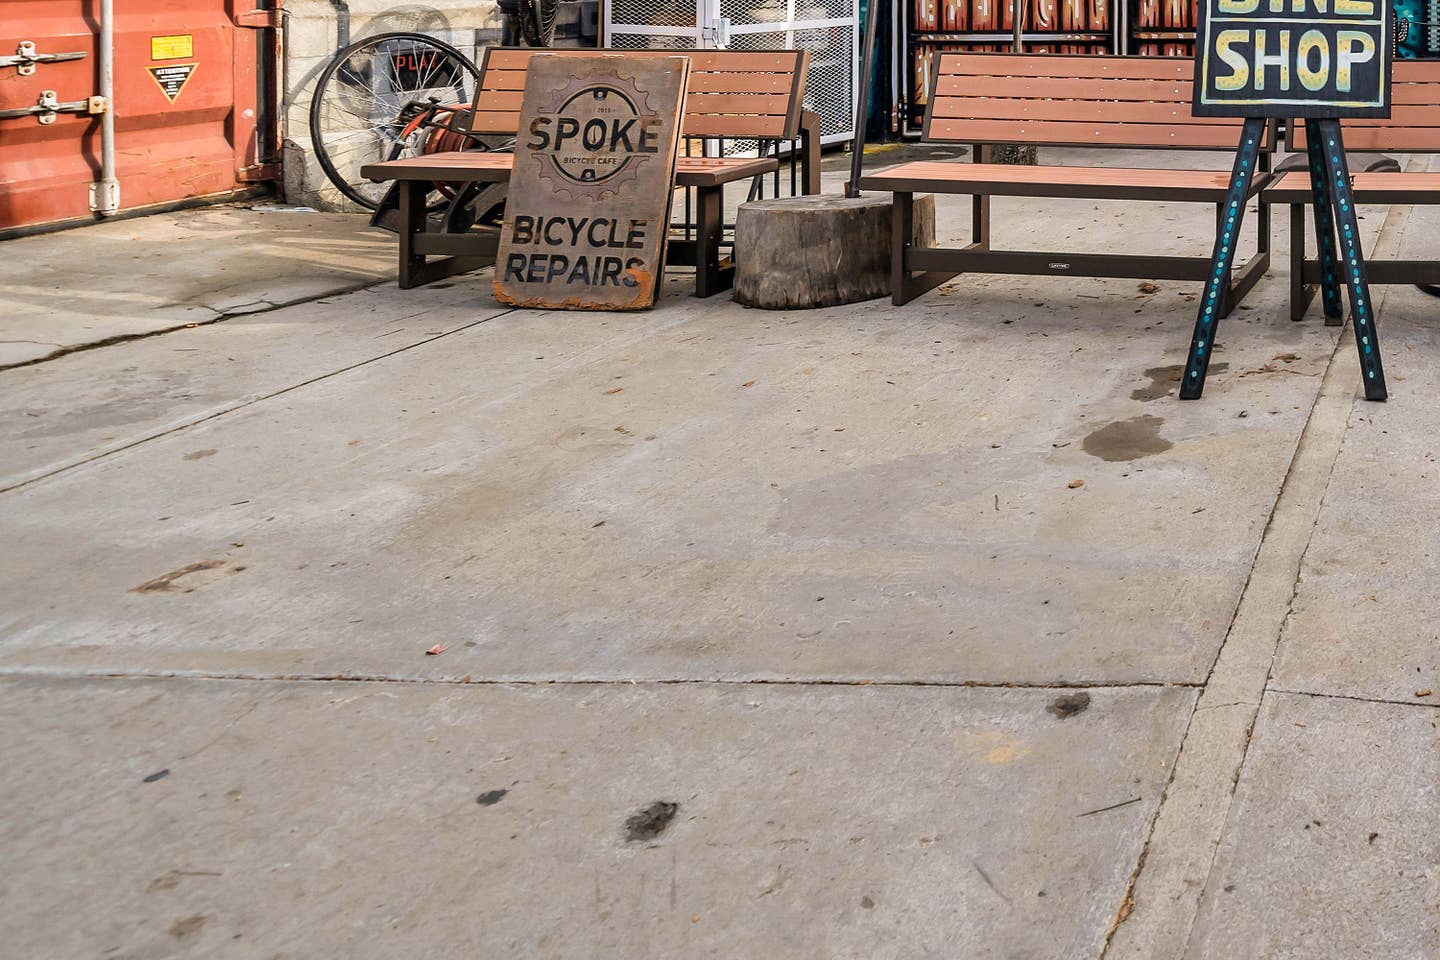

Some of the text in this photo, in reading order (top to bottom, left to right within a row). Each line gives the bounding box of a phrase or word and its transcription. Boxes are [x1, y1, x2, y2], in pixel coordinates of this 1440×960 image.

[1215, 29, 1376, 92] SHOP
[526, 116, 662, 153] SPOKE
[597, 157, 618, 165] CAFE
[512, 215, 647, 249] BICYCLE
[504, 253, 645, 288] REPAIRS
